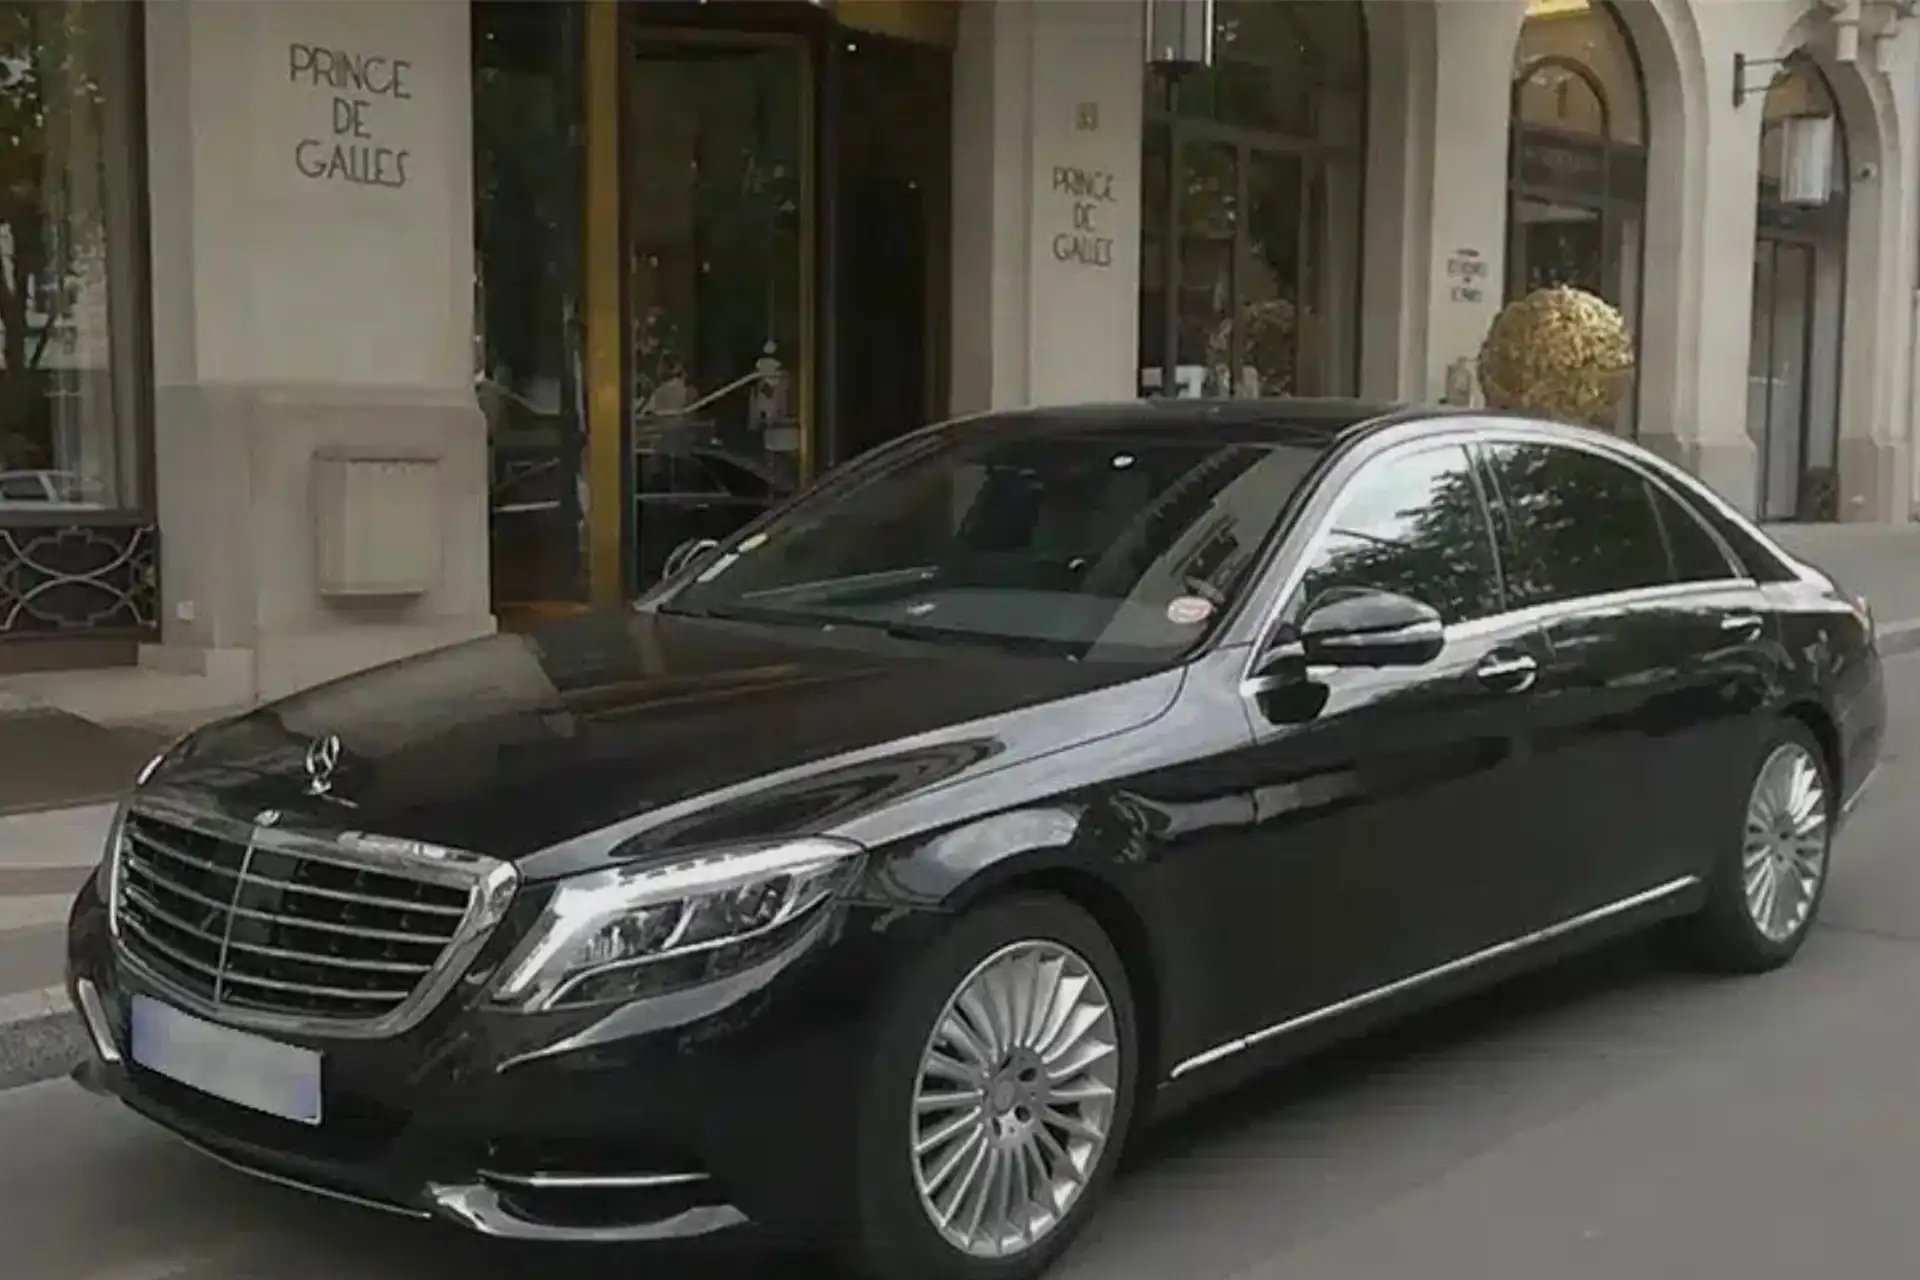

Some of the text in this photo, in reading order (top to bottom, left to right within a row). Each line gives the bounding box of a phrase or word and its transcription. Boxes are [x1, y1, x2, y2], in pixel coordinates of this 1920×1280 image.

[289, 43, 412, 99] PRINCE
[333, 96, 372, 139] DE
[296, 138, 410, 188] GALLES
[1053, 165, 1117, 202] PRINCE
[1053, 232, 1113, 268] GALLES
